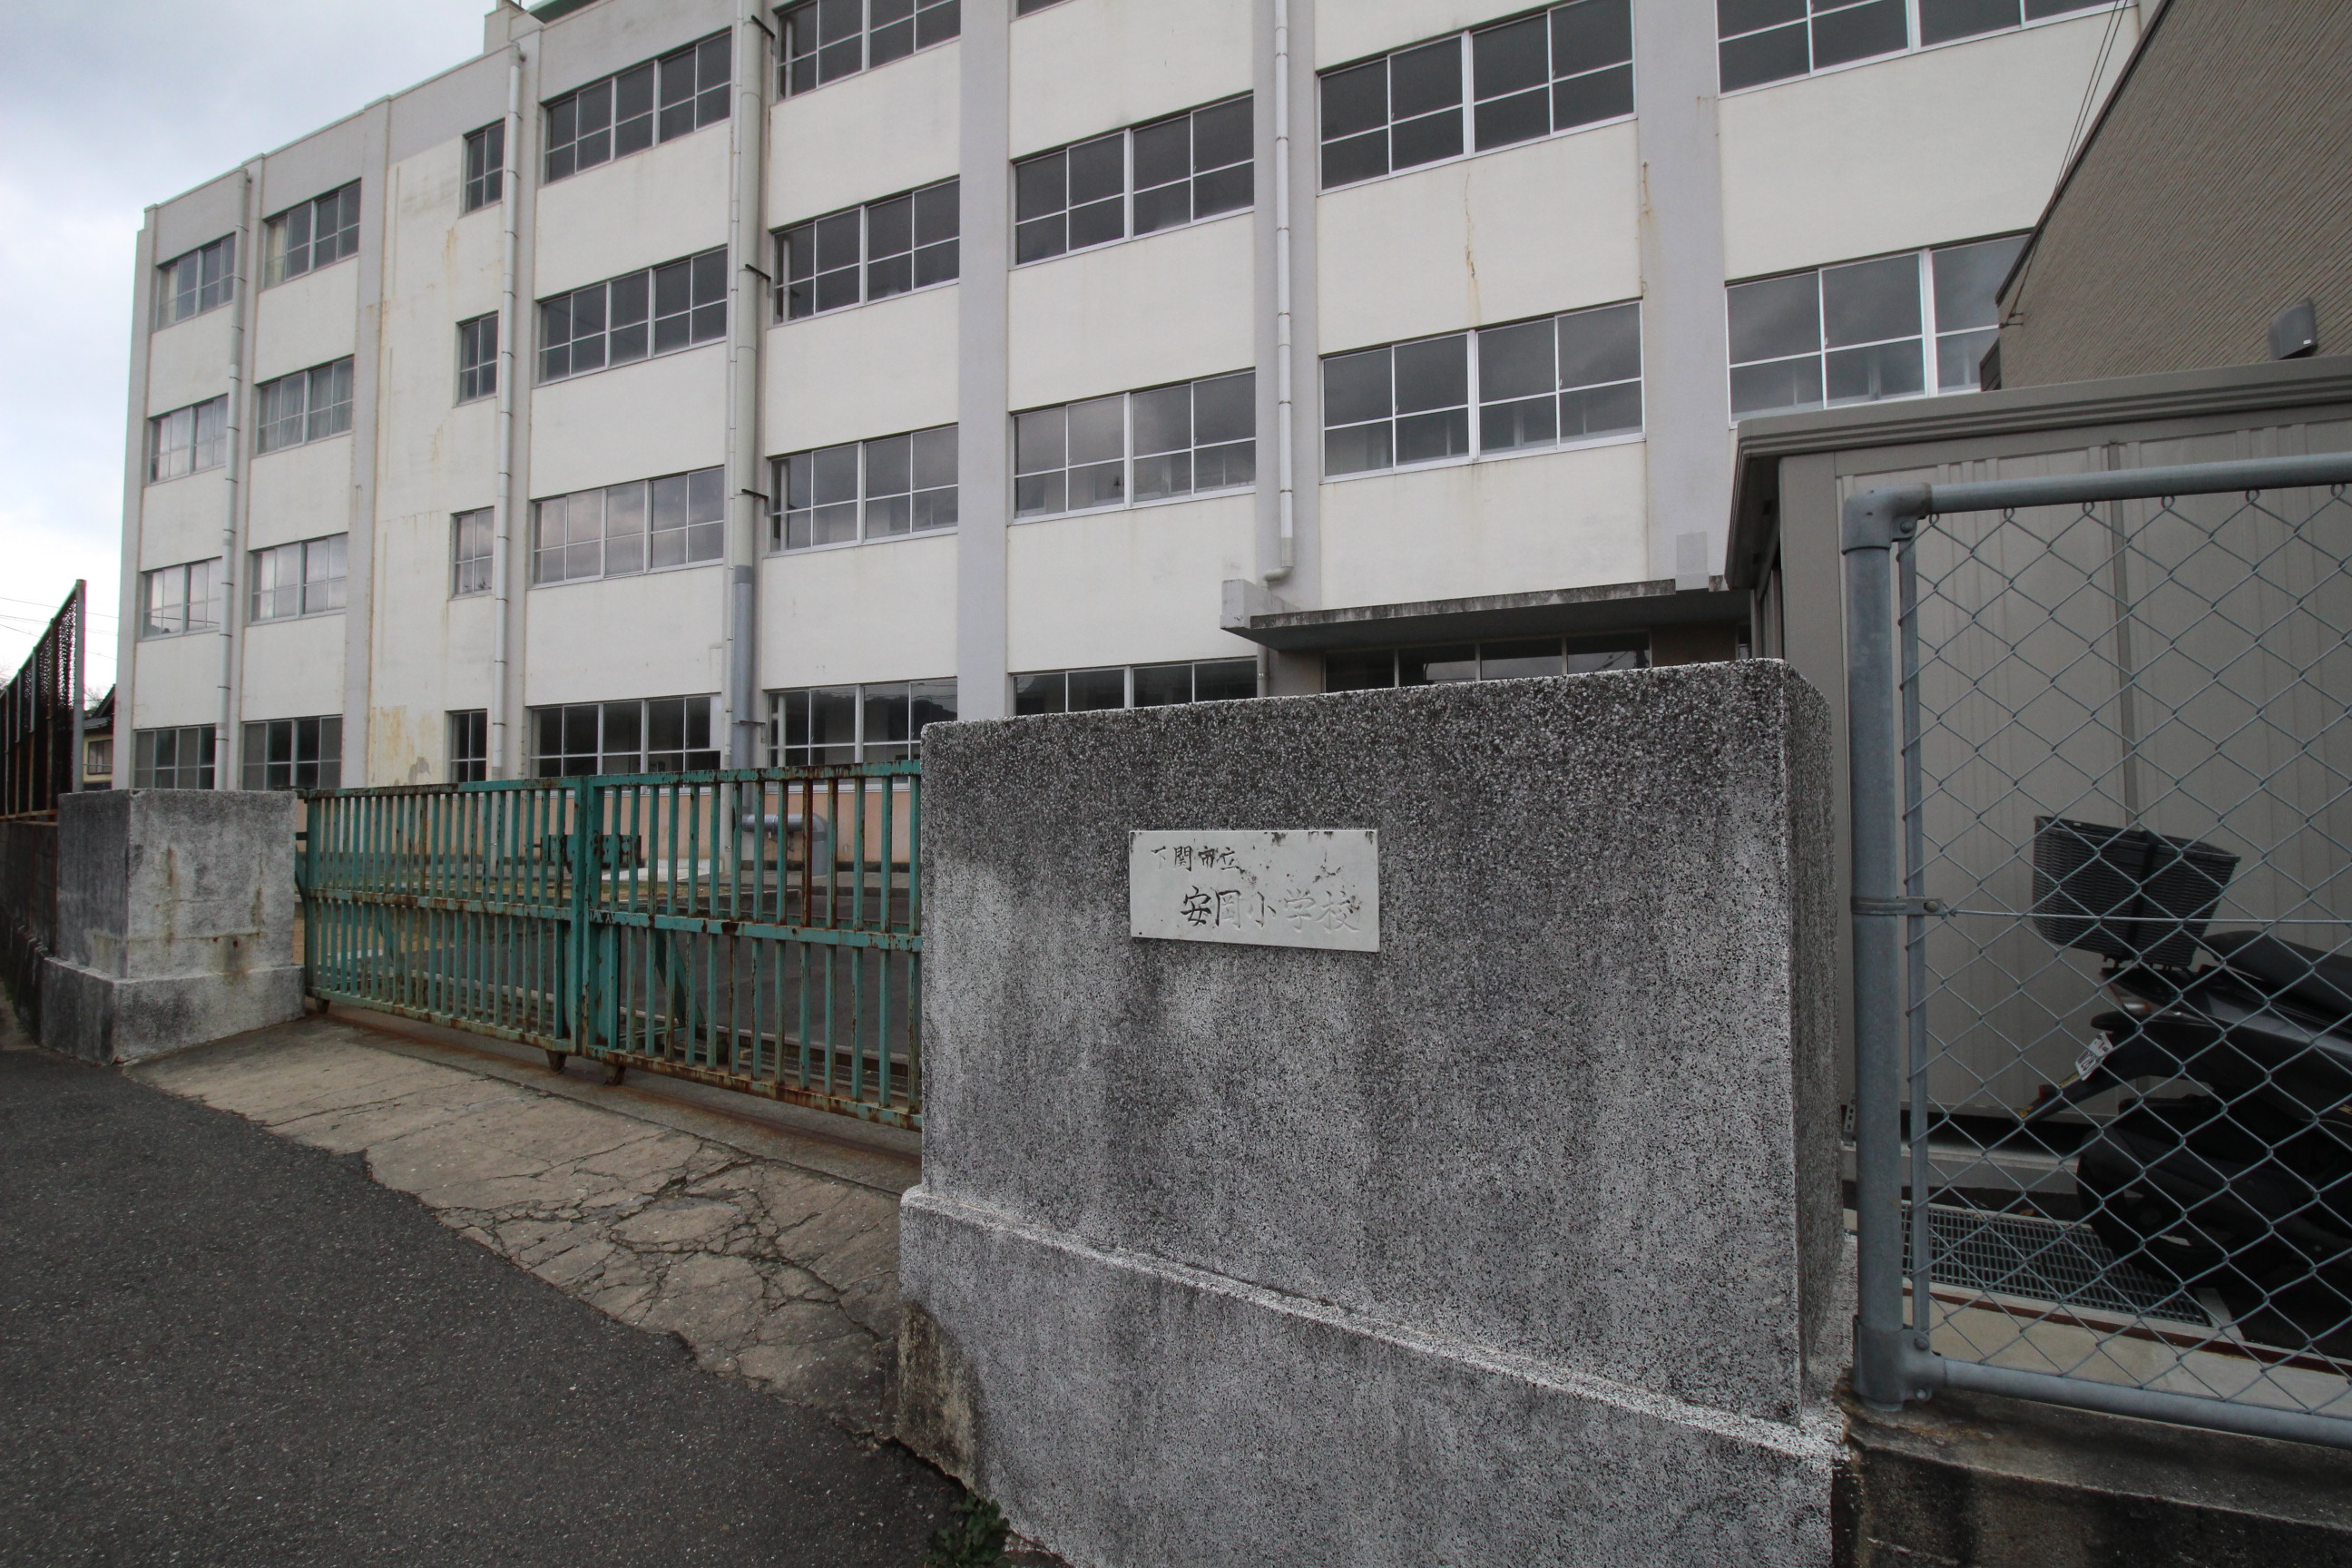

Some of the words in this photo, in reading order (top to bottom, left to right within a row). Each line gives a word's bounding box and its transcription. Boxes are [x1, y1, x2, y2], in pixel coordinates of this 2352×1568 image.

[1151, 845, 1240, 872] 下関市立
[1181, 885, 1360, 933] 安岡小学校
